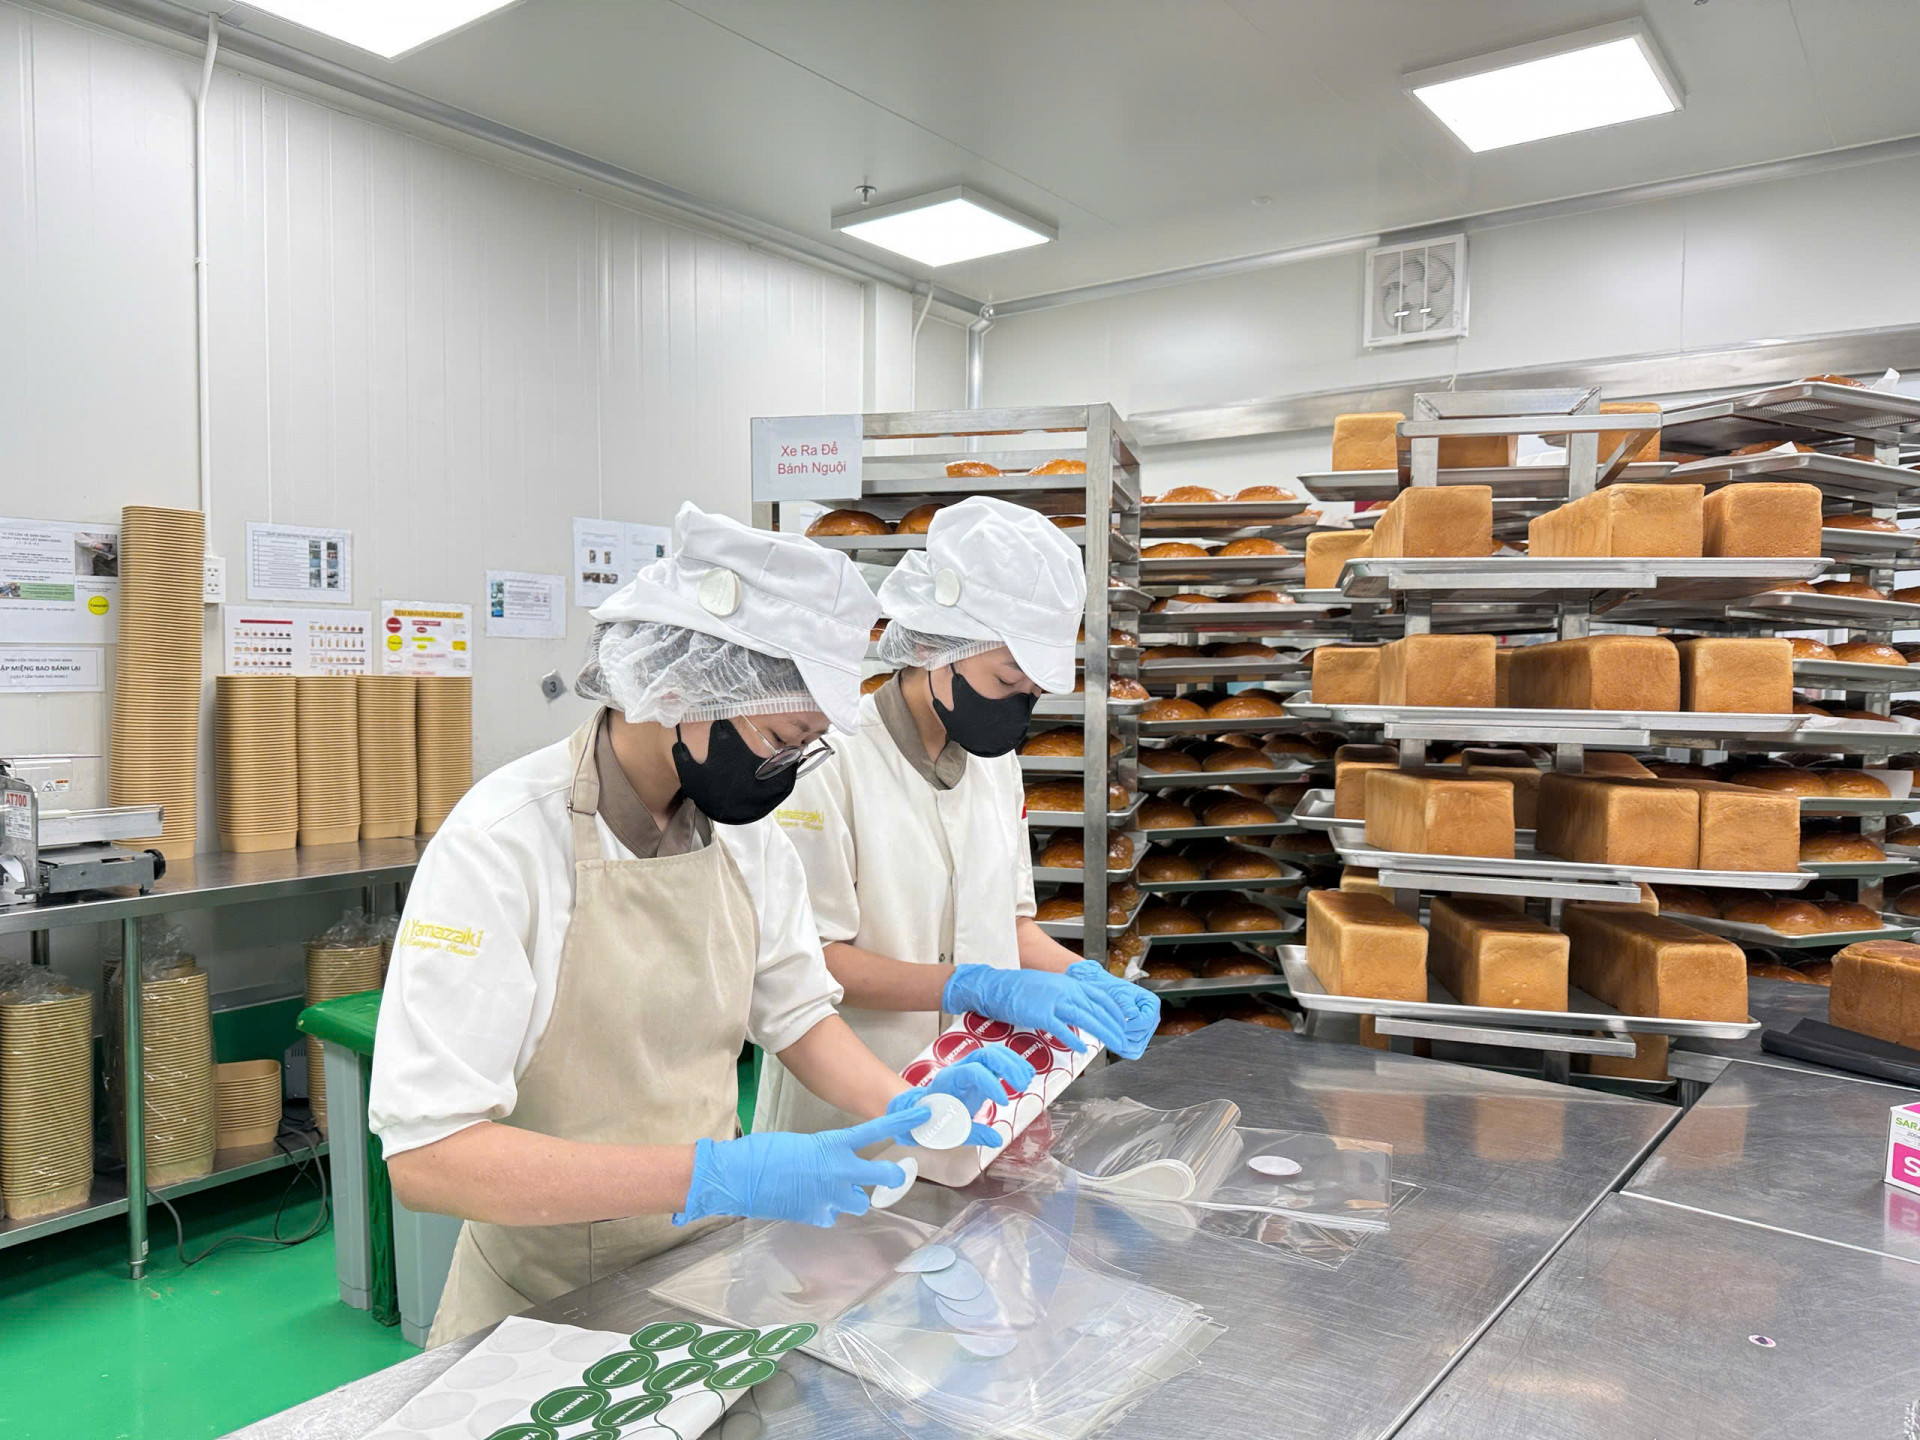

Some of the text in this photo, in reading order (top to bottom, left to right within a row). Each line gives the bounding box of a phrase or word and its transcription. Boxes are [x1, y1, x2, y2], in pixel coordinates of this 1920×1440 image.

[781, 441, 838, 457] Xe Ra Để
[777, 461, 847, 476] Bánh Nguội
[550, 681, 556, 693] 3
[6, 792, 27, 807] AT700
[410, 919, 484, 947] Yamazaki
[647, 1326, 685, 1347] Yamazaki
[707, 1334, 744, 1356] Yamazaki
[767, 1327, 802, 1352] Yamazaki
[601, 1357, 641, 1384] Yamazaki
[662, 1365, 703, 1390] Yamazaki
[724, 1361, 763, 1386] Yamazaki
[550, 1393, 593, 1422] Yamazaki
[611, 1398, 655, 1425] Yamazaki
